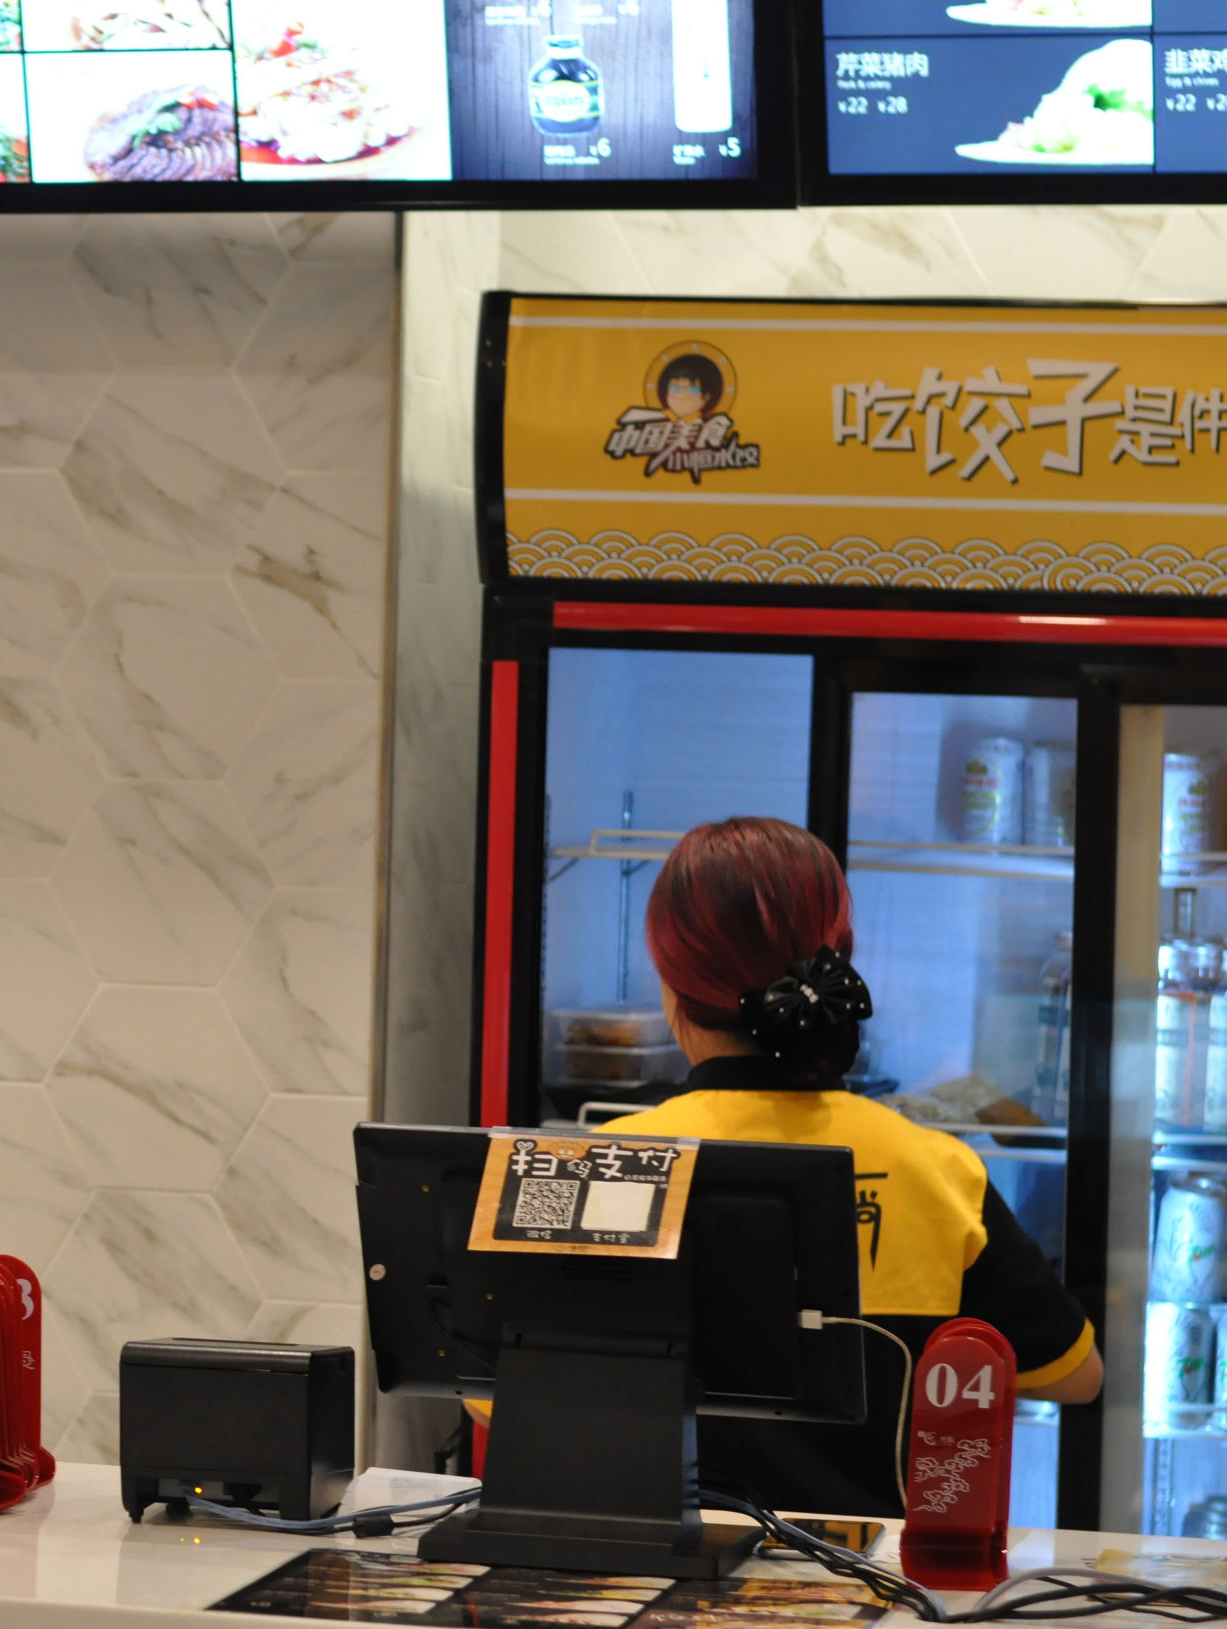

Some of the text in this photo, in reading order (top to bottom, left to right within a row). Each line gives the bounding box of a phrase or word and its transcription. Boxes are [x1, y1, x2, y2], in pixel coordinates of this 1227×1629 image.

[836, 51, 929, 78] 芹菜猪肉
[925, 1363, 995, 1409] 04
